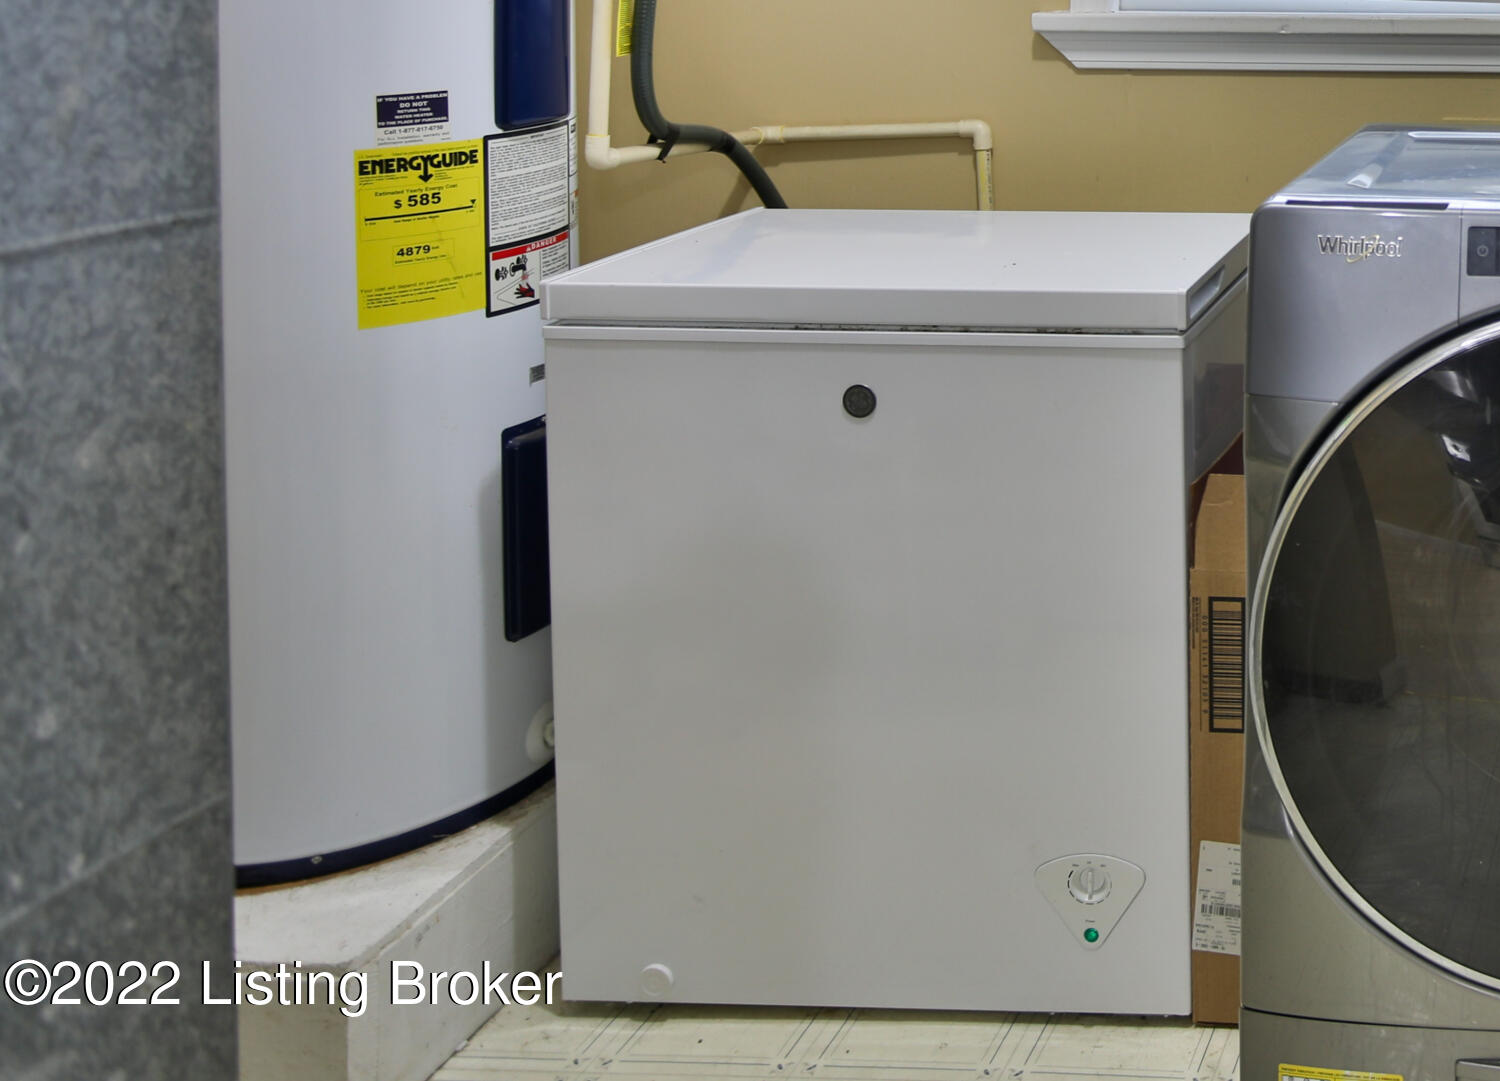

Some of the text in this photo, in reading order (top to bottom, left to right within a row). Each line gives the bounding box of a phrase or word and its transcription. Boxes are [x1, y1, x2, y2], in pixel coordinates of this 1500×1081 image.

[358, 149, 479, 182] ENERGYGUIDE
[375, 189, 404, 197] Estimated
[425, 185, 444, 193] Energy
[393, 192, 442, 209] $ 585
[397, 244, 431, 257] 4879
[1317, 234, 1404, 261] Whirlpool
